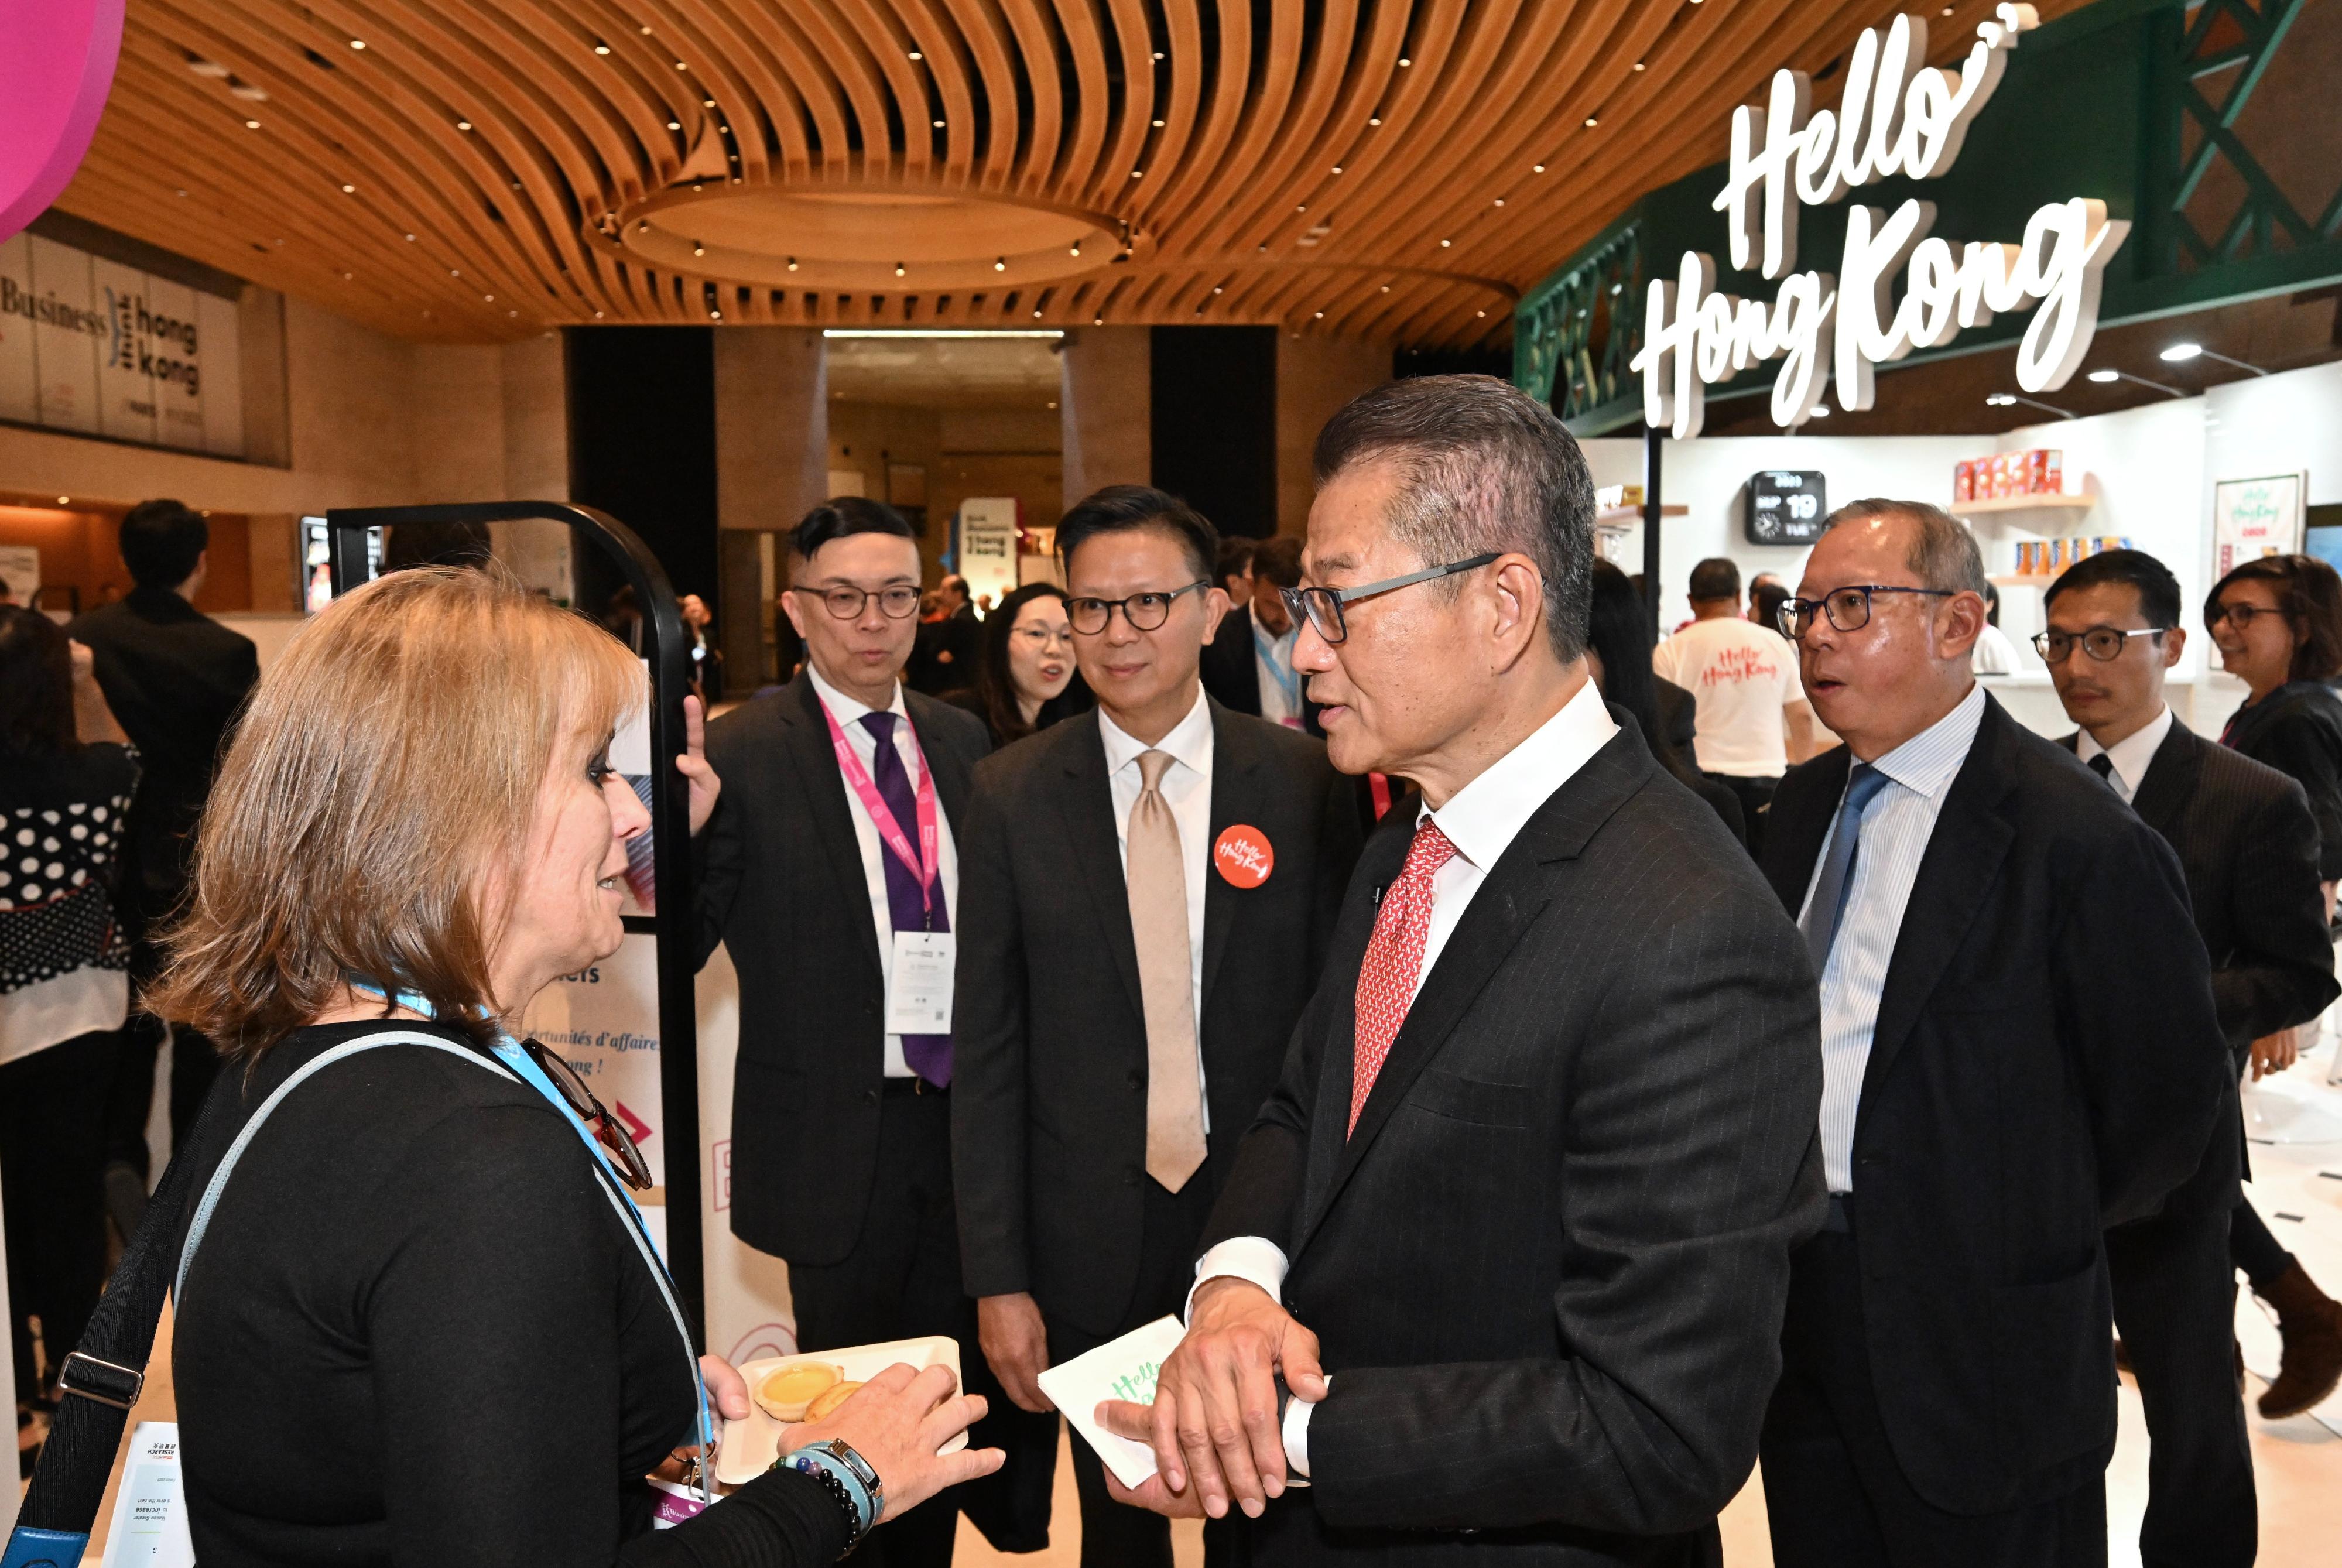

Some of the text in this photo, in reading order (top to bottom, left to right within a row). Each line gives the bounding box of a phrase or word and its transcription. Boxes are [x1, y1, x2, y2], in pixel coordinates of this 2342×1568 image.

[1711, 12, 1991, 280] Hello
[1, 277, 109, 338] Business
[135, 293, 198, 355] hong
[1629, 196, 2110, 440] Hong Kong
[137, 337, 200, 396] kong
[1786, 494, 1817, 519] 19
[1703, 660, 1777, 686] Hong Kong
[1718, 646, 1764, 667] Hello
[1219, 842, 1268, 878] Hong Kong
[1234, 838, 1266, 860] Hello
[595, 1032, 660, 1052] d'affaire
